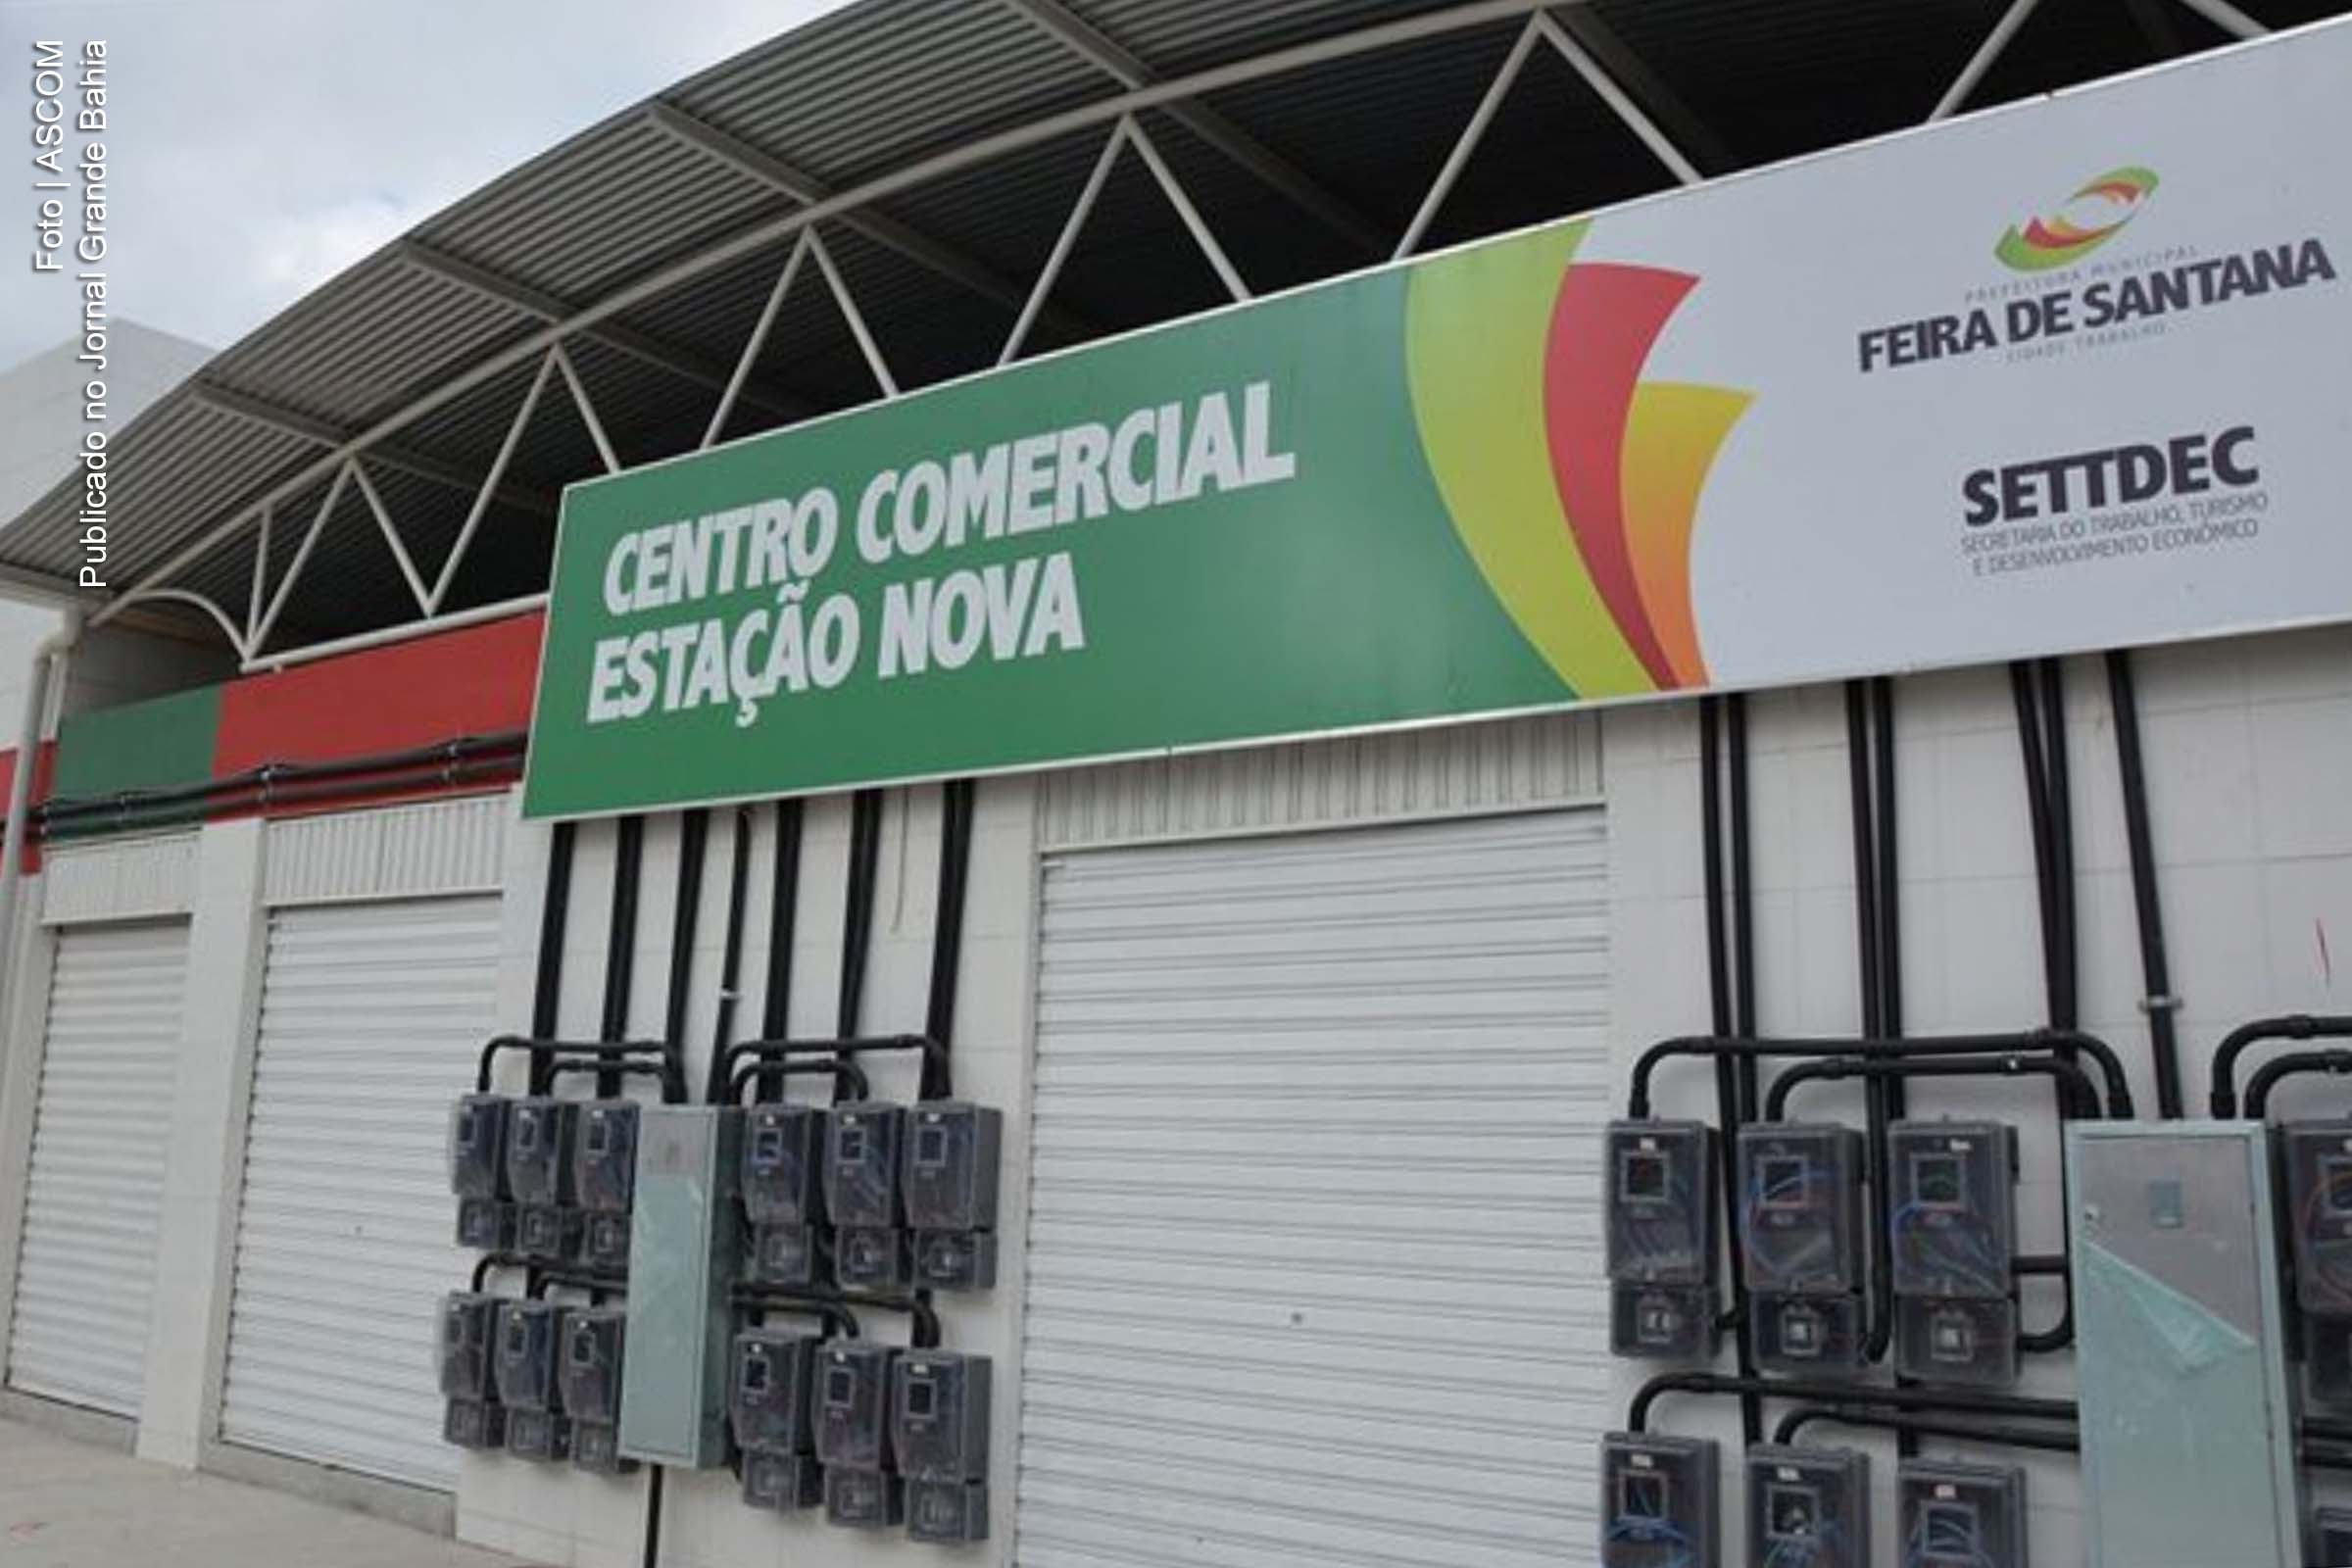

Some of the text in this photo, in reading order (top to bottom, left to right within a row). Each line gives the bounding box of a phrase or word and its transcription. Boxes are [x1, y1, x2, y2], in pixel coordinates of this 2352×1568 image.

[1858, 237, 2336, 373] FEIRA DE SANTANA
[604, 381, 1296, 617] CENTRO COMERCIAL
[1961, 524, 2057, 556] SECRETARIA
[2059, 519, 2086, 539] DO
[2190, 492, 2269, 520] TURISMO
[1962, 425, 2260, 528] SETTDEC
[1973, 517, 2259, 576] E DESENVOLVIMENTO ECONÔMICO
[587, 551, 1086, 726] ESTAÇÃO NOVA
